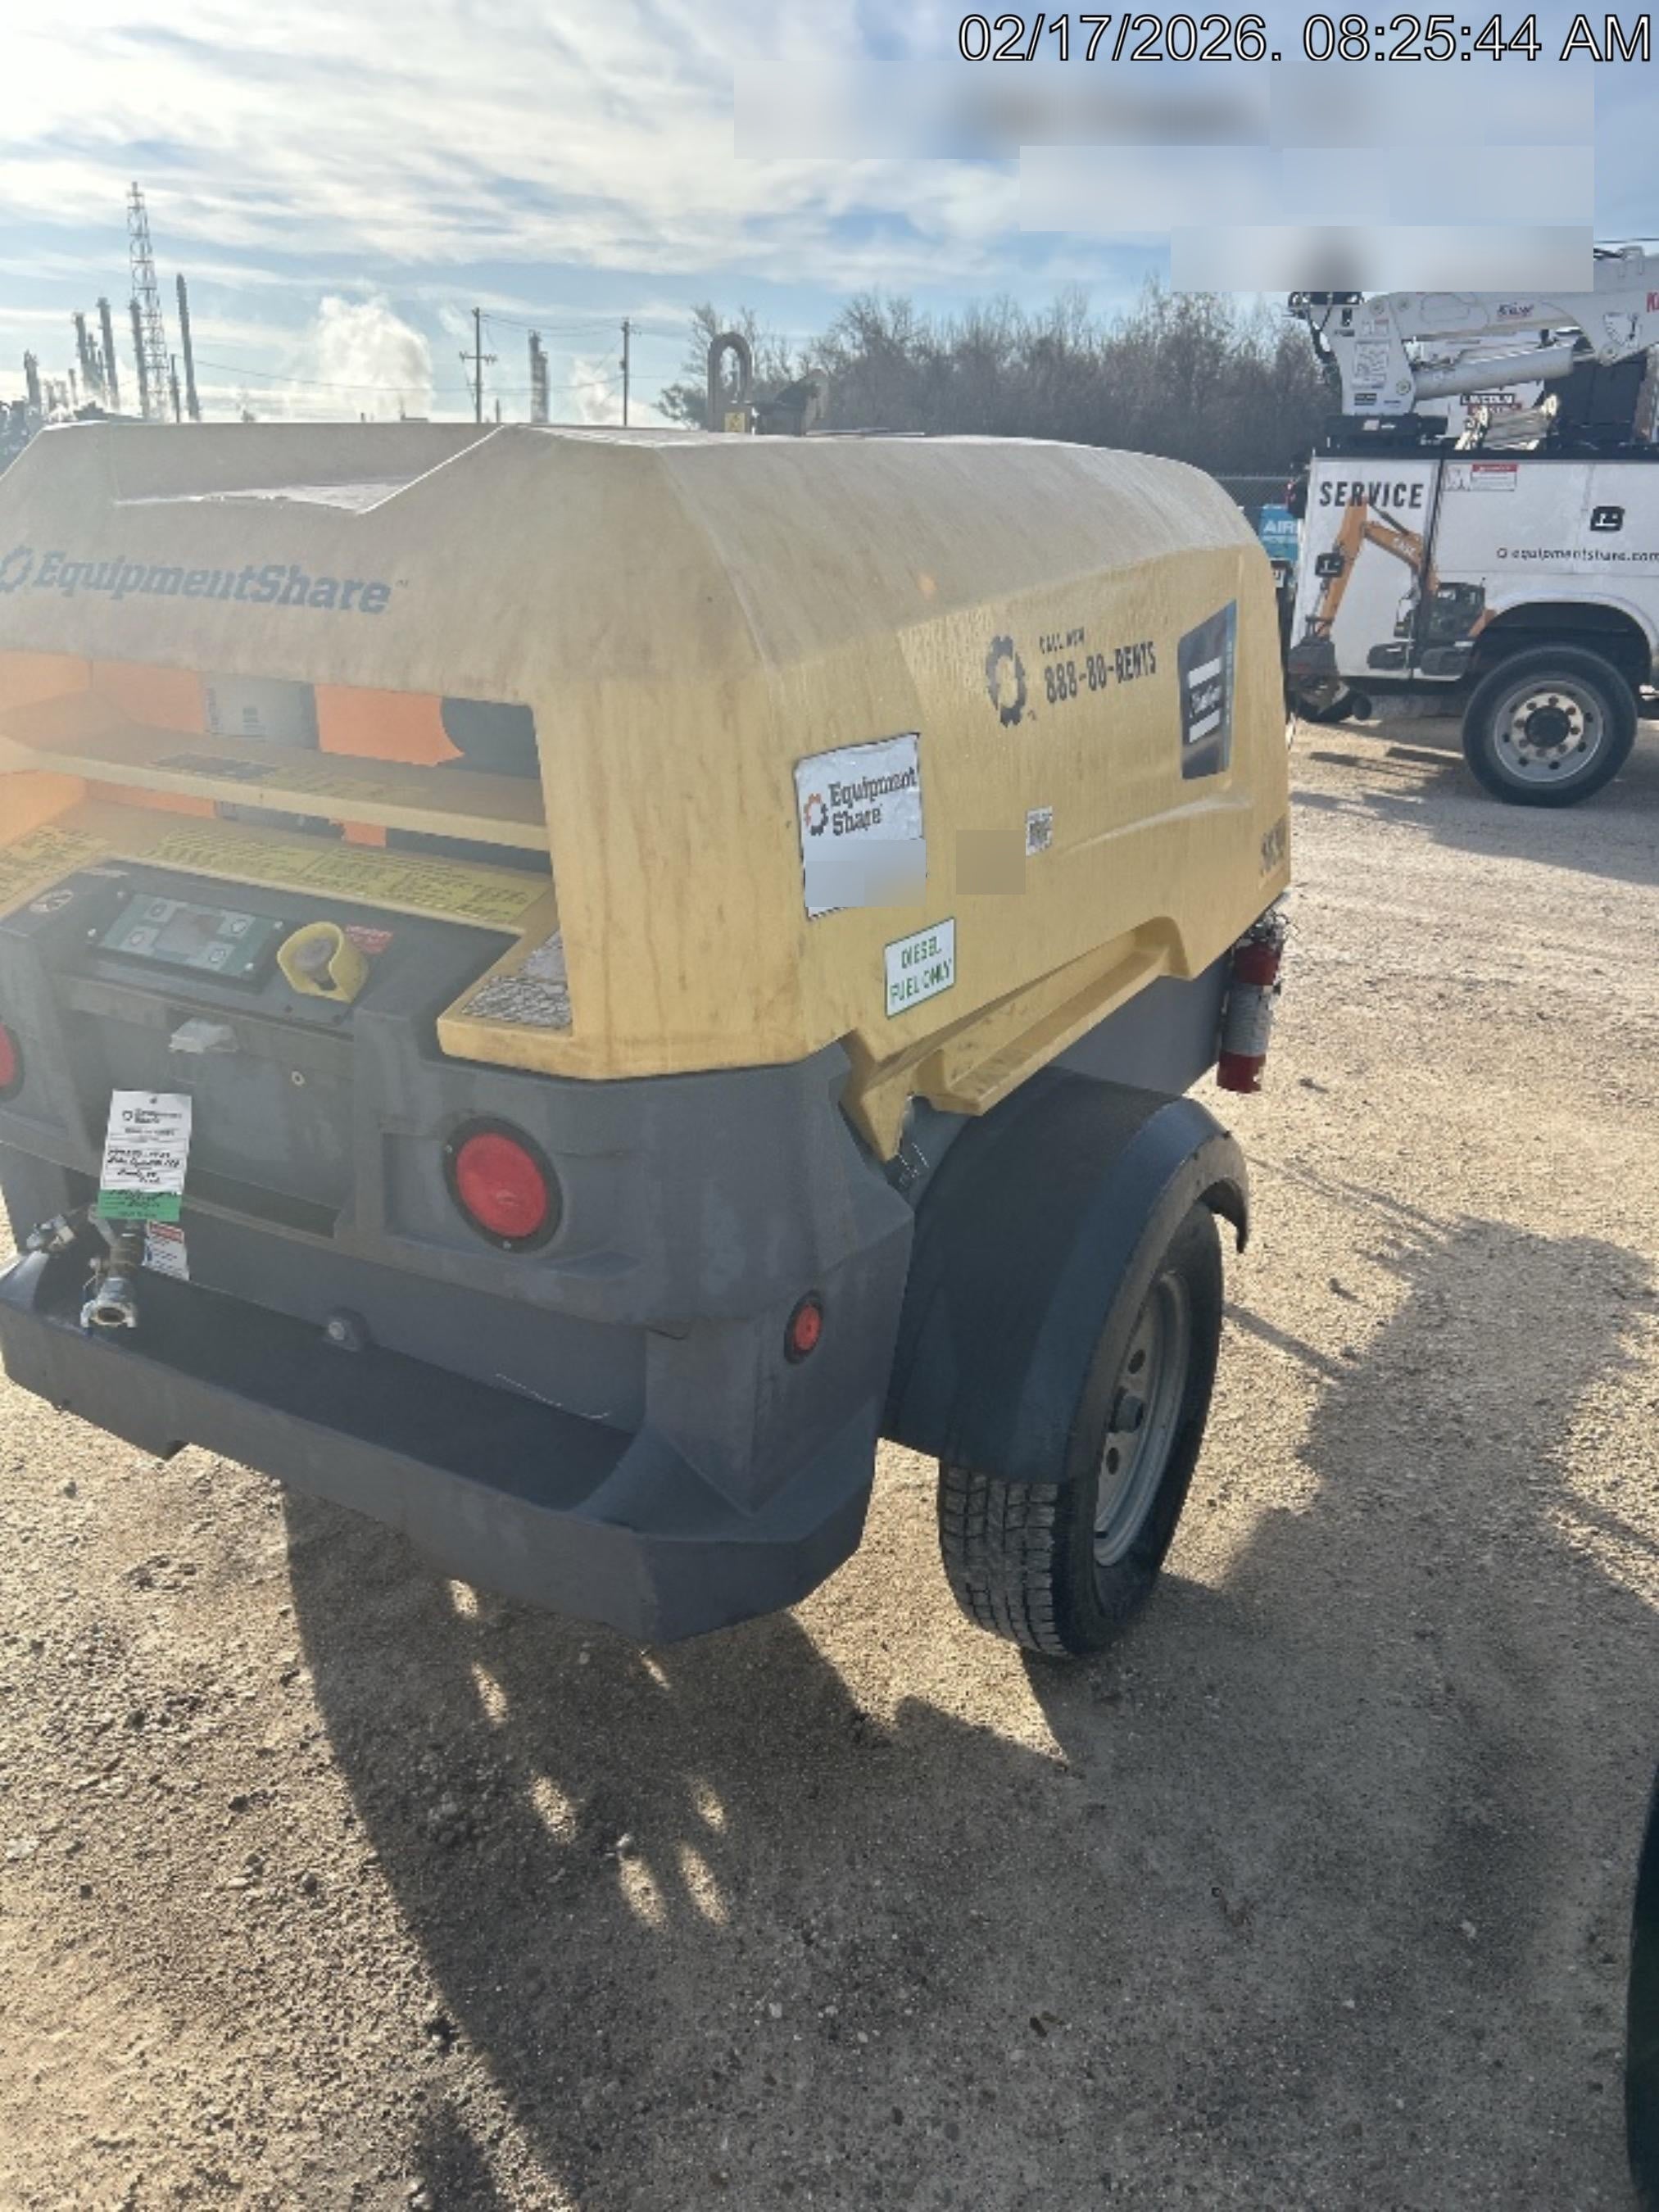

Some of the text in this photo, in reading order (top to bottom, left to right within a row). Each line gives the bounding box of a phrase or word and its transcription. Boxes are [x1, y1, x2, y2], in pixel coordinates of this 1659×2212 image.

[1319, 482, 1424, 509] SERVICE
[32, 551, 392, 614] EquipmentShare
[1045, 641, 1156, 704] 888-80-RENTS
[827, 767, 917, 809] Equipment
[832, 806, 881, 836] Share
[902, 936, 942, 969] DIESEL
[890, 958, 952, 1004] FUEL ONLY
